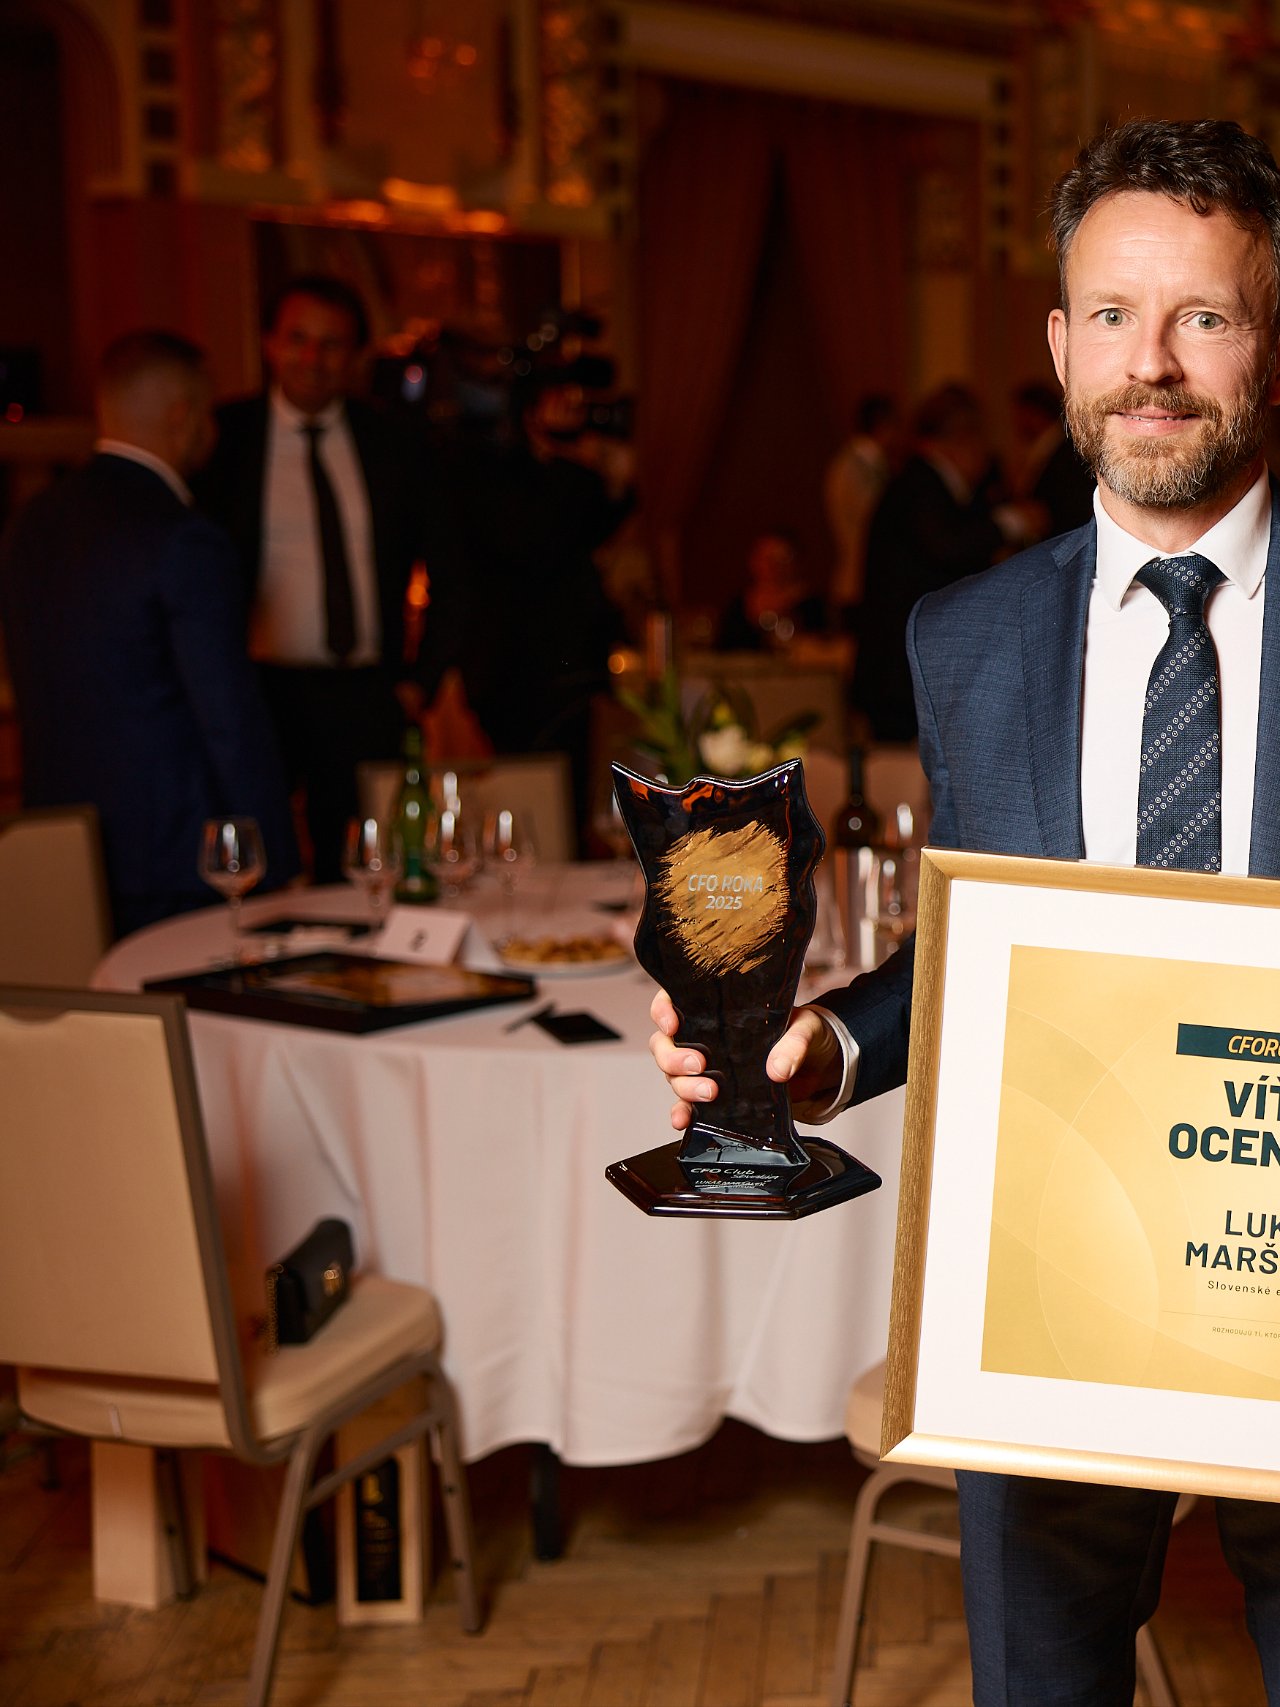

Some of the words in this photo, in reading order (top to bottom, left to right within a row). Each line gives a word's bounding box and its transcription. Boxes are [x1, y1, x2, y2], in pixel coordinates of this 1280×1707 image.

[688, 874, 719, 892] CFO
[721, 874, 764, 892] ROKA
[705, 895, 744, 910] 2025
[1207, 1280, 1271, 1295] Slovenské
